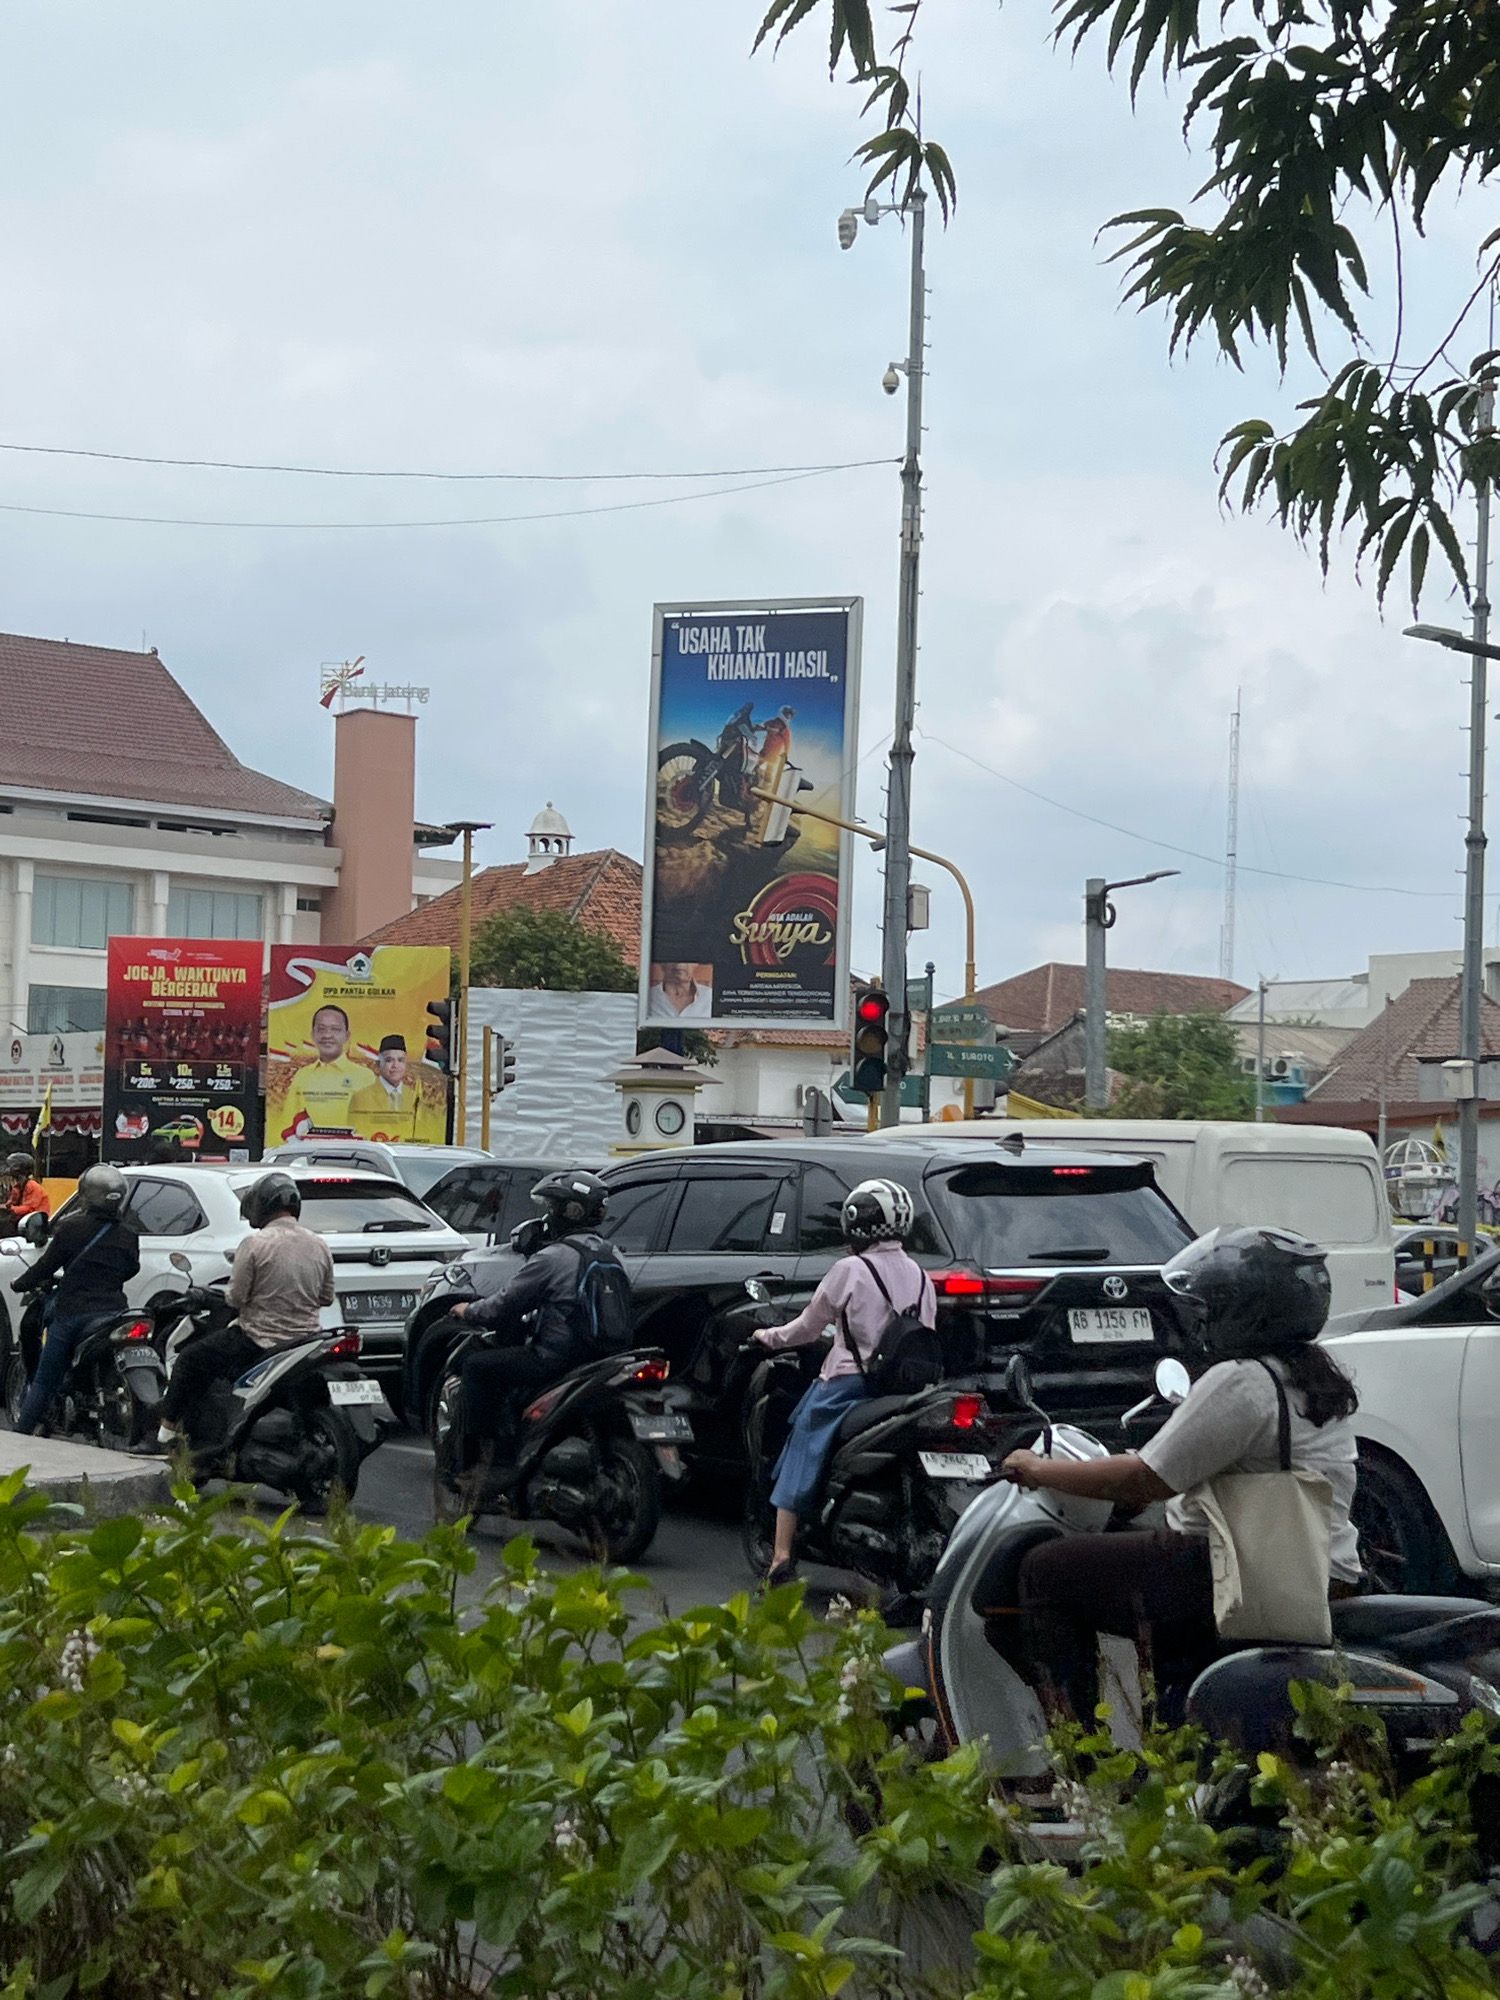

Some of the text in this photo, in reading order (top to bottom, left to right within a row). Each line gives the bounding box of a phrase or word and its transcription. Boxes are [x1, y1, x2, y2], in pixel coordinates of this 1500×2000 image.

[736, 625, 766, 652] TAK
[707, 652, 780, 681] KHIANATI
[728, 911, 832, 958] Surya
[123, 965, 247, 984] JOGJA, WAKTUNYA
[151, 981, 218, 998] BERGERAK
[961, 1051, 994, 1062] SUROTO
[218, 1110, 235, 1128] 14
[345, 1296, 359, 1310] AB
[1073, 1309, 1150, 1330] AB 1156 FM
